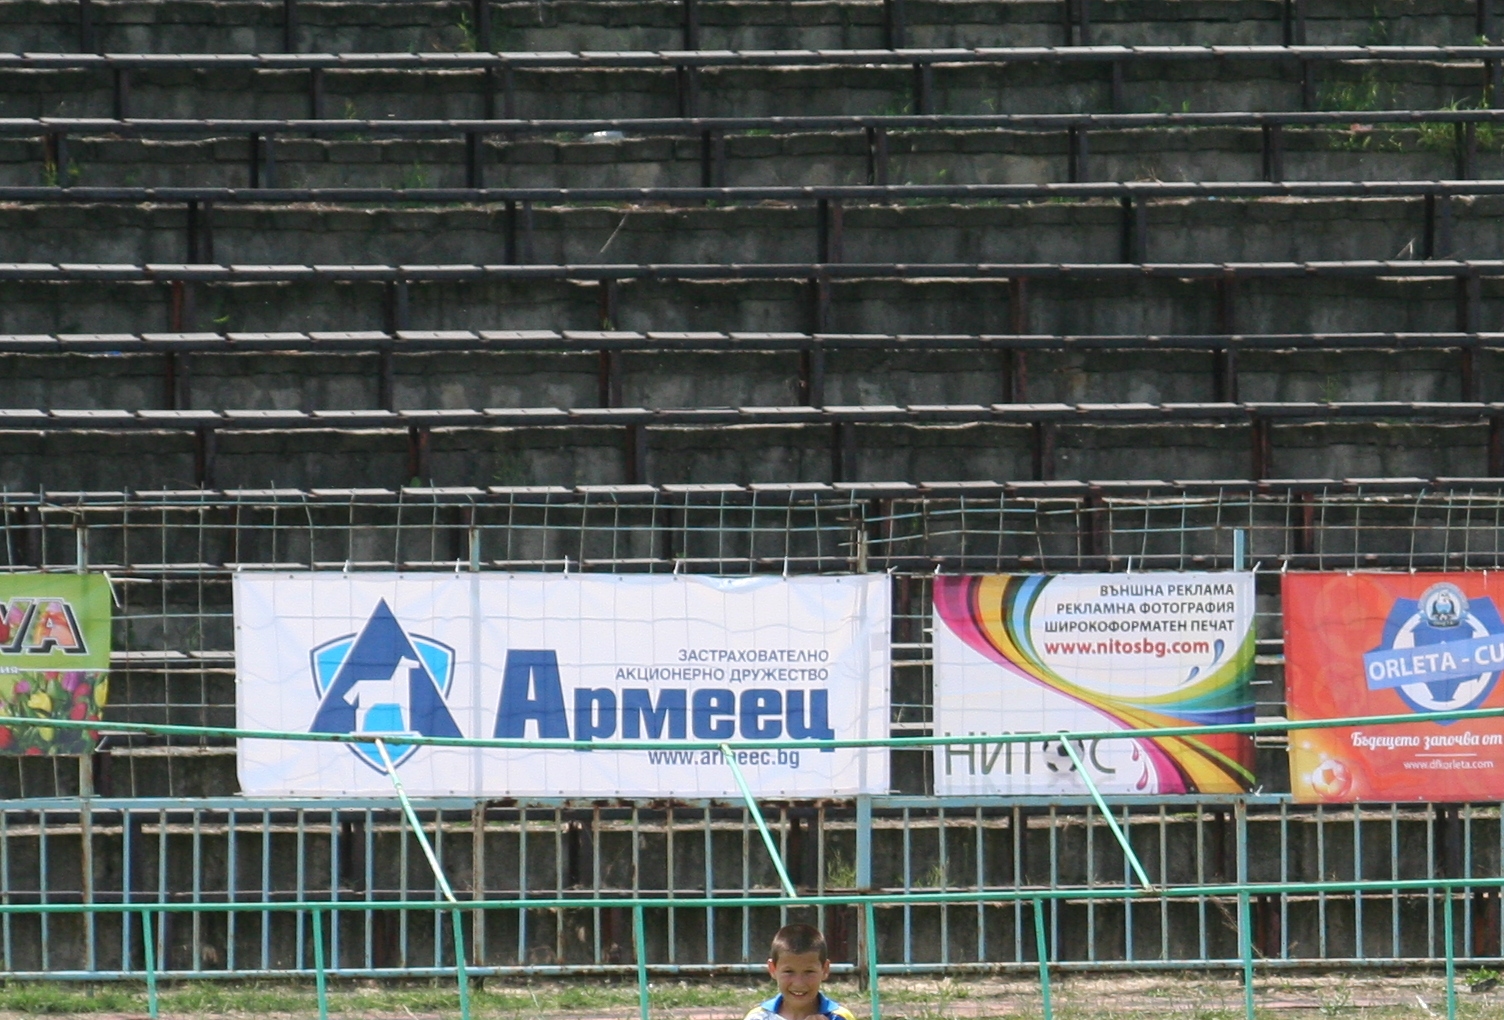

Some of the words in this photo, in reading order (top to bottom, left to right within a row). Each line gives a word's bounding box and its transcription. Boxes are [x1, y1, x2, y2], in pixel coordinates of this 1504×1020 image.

[1100, 584, 1164, 596] ВЪНШНА
[1168, 584, 1234, 596] РЕКЛАМА
[1057, 603, 1136, 614] РЕКЛАМНА
[1139, 602, 1234, 614] ФОТОГРАФИЯ
[1044, 620, 1187, 633] ШИРОКОФОРМАТЕН
[1190, 620, 1235, 631] ПЕЧАТ
[678, 649, 829, 662] ЗАСТРАХОВАТЕЛНО
[1045, 638, 1209, 658] www.nitosbg.com
[1369, 652, 1457, 681] ORLETA
[615, 667, 725, 682] АКЦИОНЕРНО
[730, 667, 829, 683] ДРУЖЕСТВО
[494, 648, 835, 753] Армеец
[1351, 732, 1420, 750] Бъдещето
[1423, 731, 1480, 750] започва
[1482, 734, 1502, 745] от
